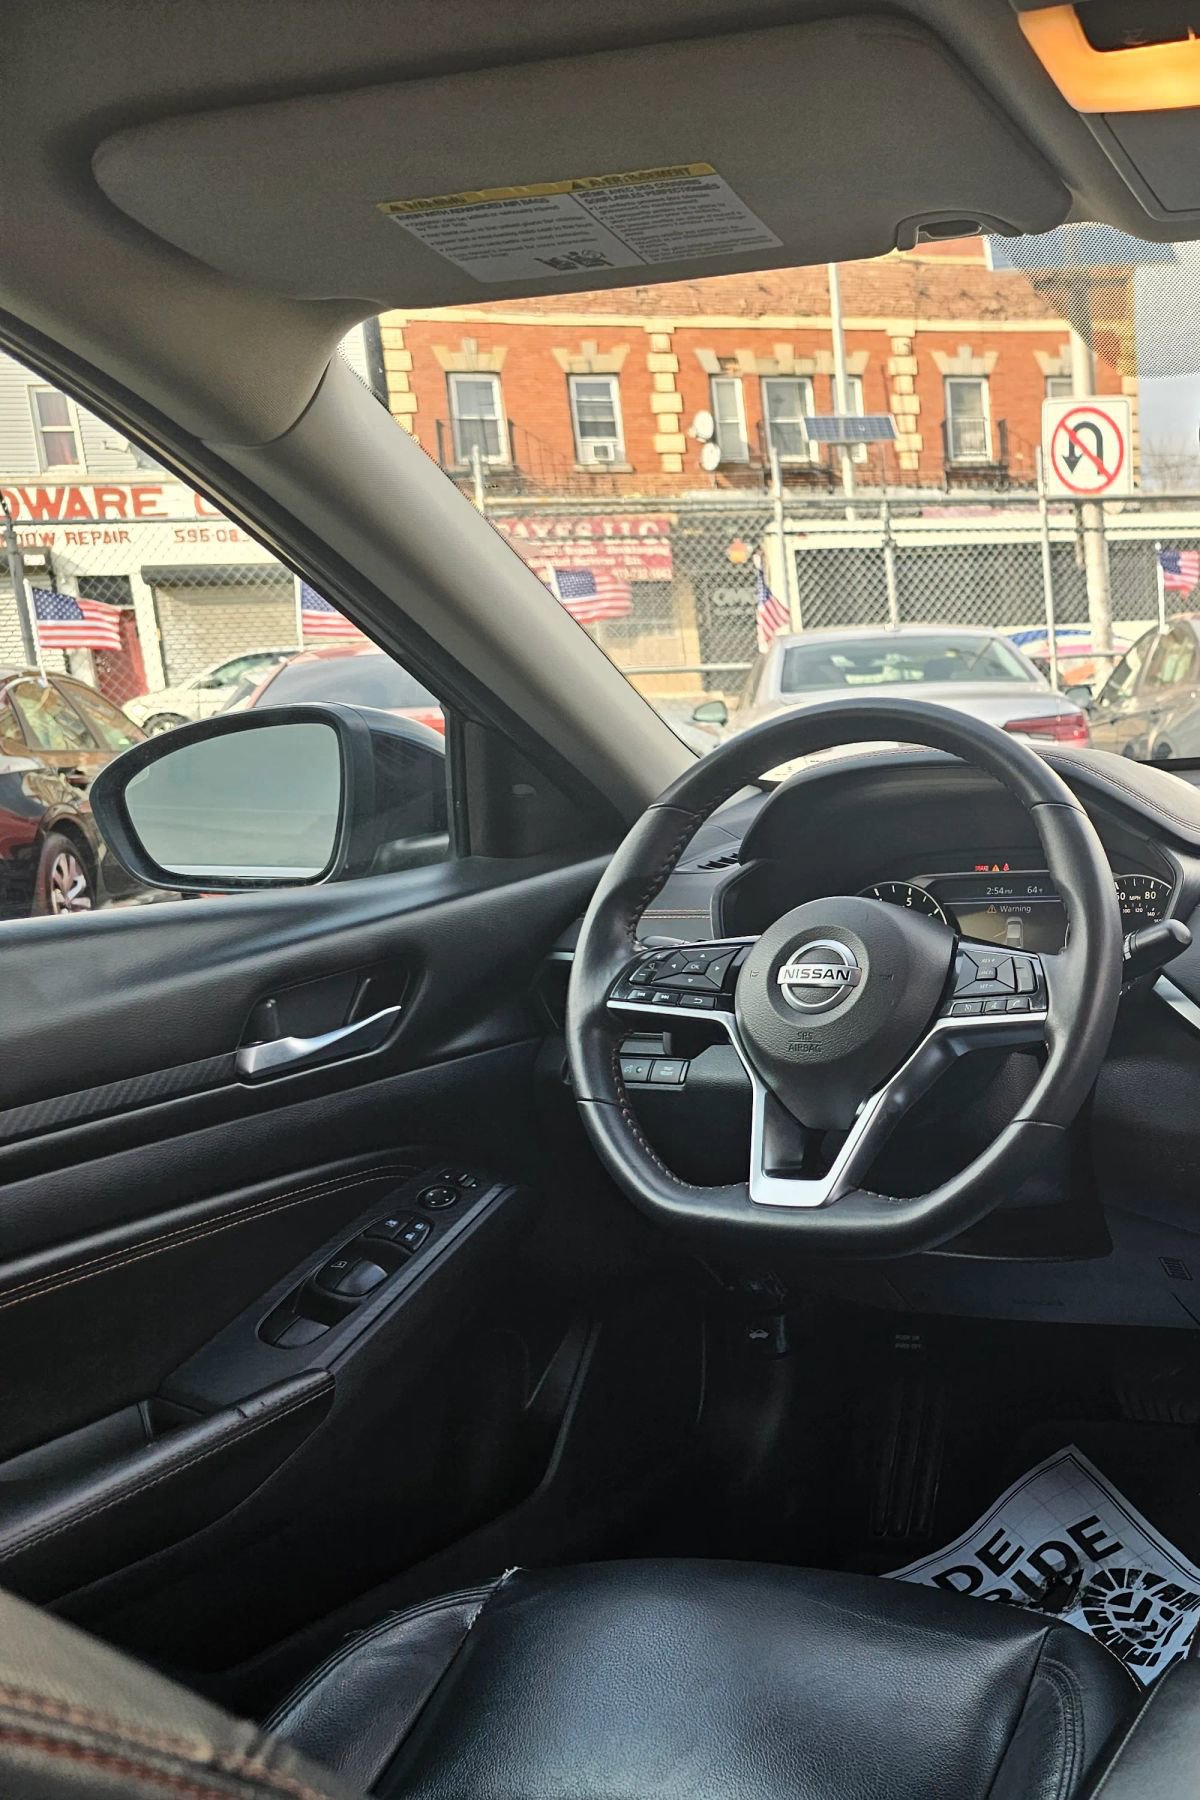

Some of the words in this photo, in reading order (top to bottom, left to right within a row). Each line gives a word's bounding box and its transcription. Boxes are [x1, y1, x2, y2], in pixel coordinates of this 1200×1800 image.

[66, 530, 132, 545] REPAIR
[986, 887, 1004, 895] 2:54
[1027, 886, 1038, 894] 64
[1144, 891, 1156, 899] 80
[905, 897, 912, 906] 5
[1000, 905, 1031, 914] Warning
[783, 968, 851, 981] NISSAN
[788, 1043, 823, 1053] AIRBAG
